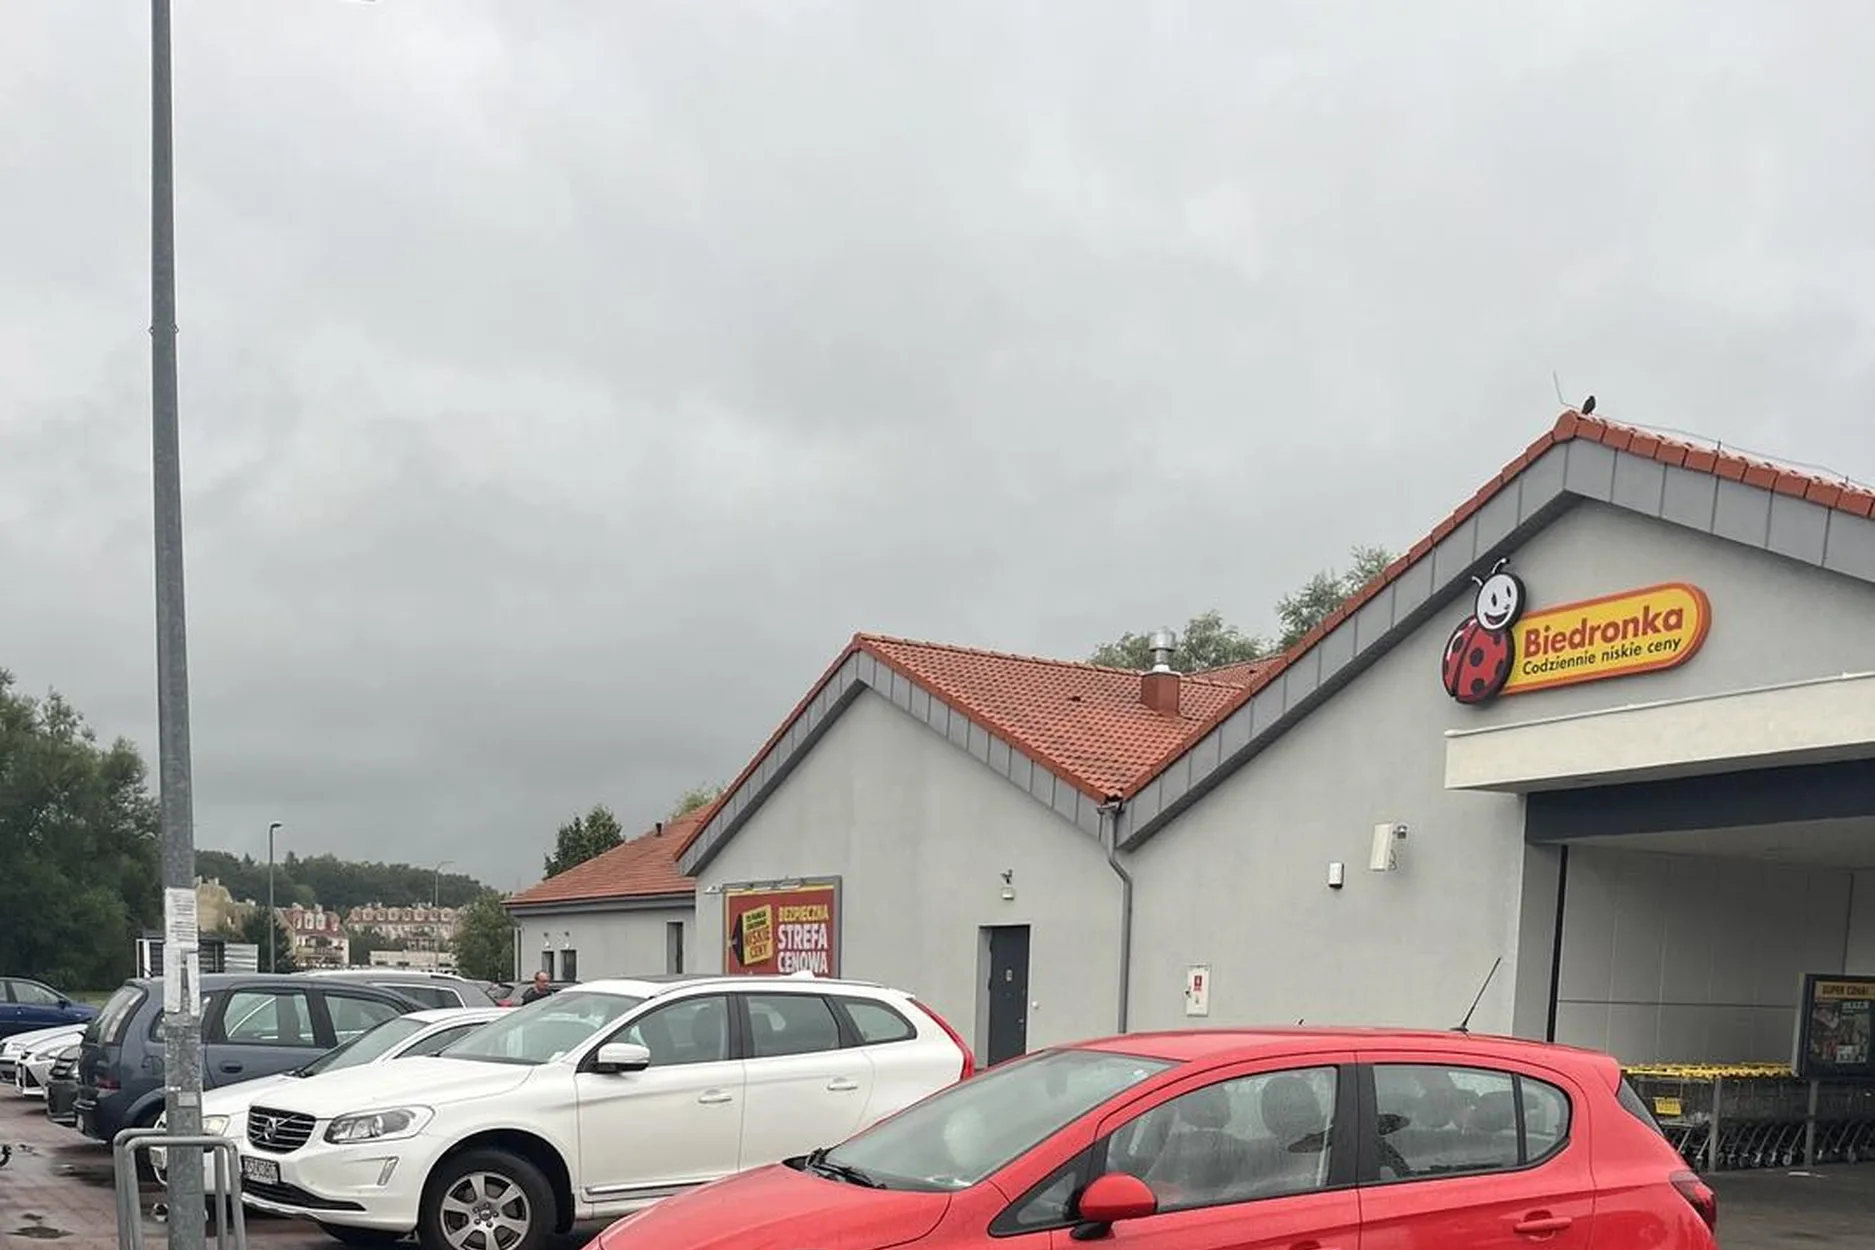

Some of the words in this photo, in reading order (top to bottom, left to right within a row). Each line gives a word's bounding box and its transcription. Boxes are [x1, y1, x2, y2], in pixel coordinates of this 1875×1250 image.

[1524, 606, 1684, 658] Biedronka
[1523, 653, 1596, 675] Codziennie
[1602, 646, 1642, 662] niskie
[1647, 637, 1682, 654] ceny
[778, 923, 828, 950] STREFA
[778, 951, 828, 974] CENOWA
